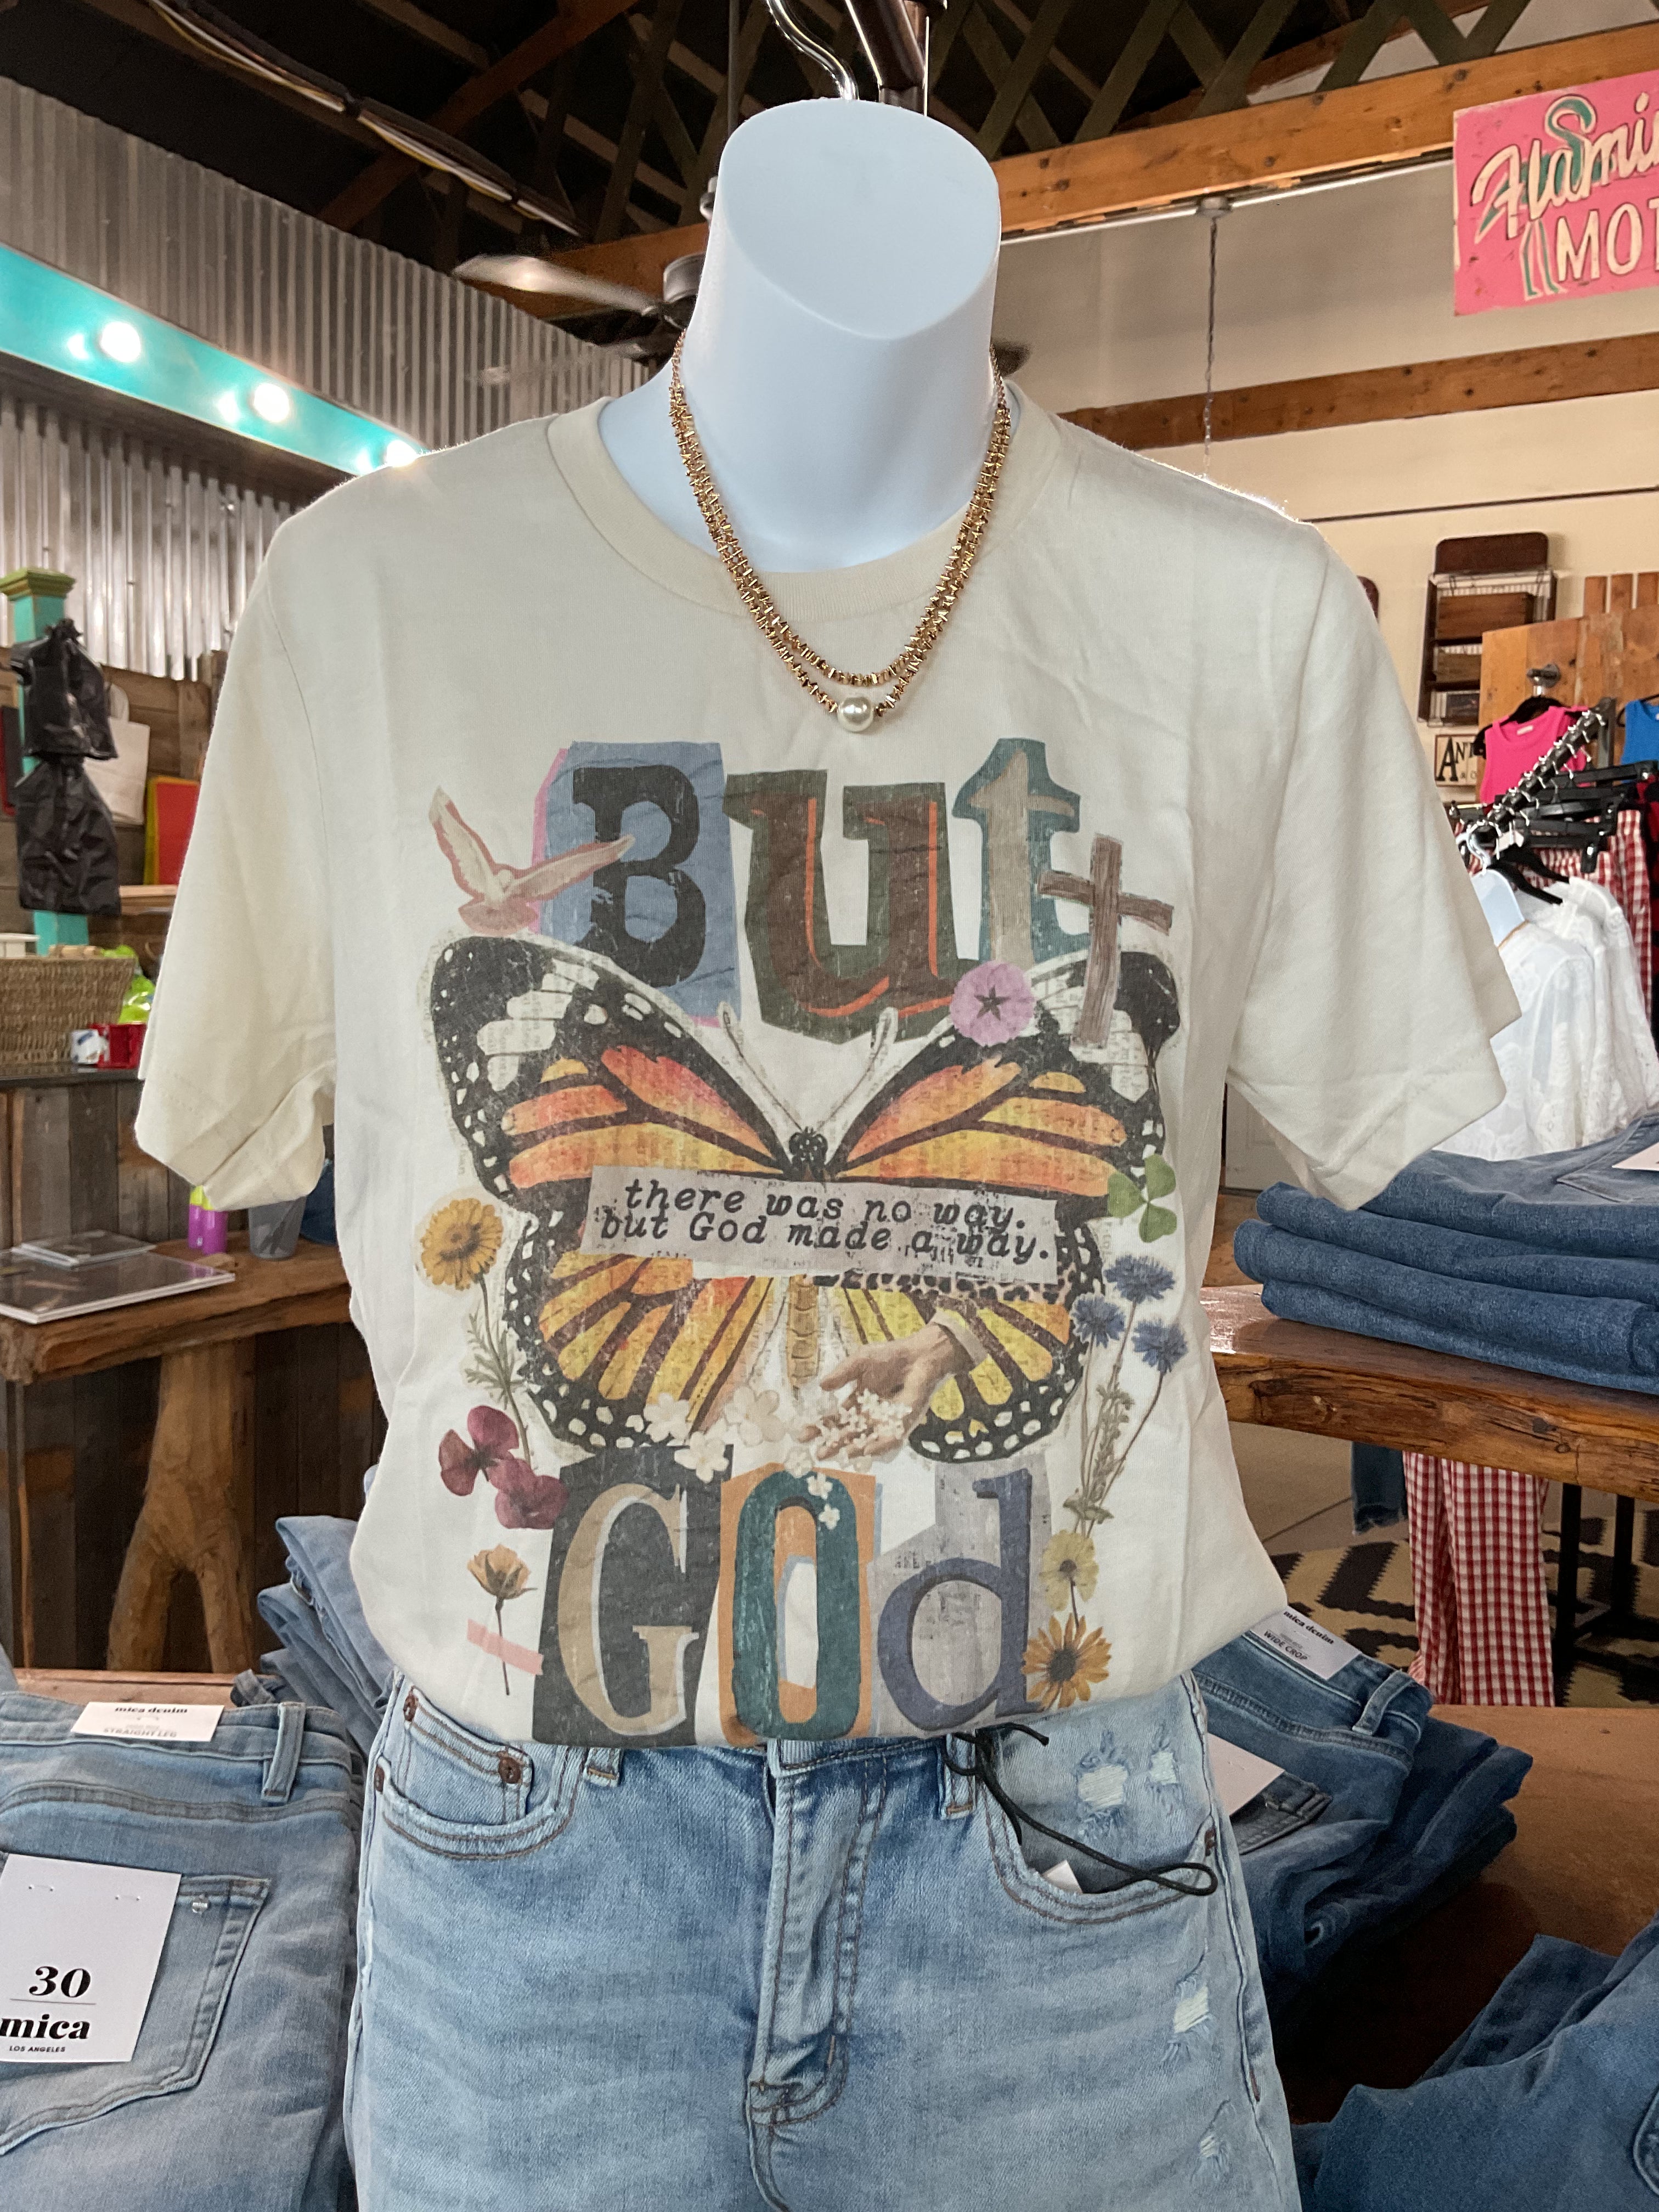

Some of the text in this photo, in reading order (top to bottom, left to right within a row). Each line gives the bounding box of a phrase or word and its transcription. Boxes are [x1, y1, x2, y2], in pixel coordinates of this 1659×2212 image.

[1470, 92, 1659, 240] Flami
[625, 1179, 1025, 1234] there was no way.
[601, 1206, 1048, 1265] but God made a way.
[1284, 1611, 1305, 1627] mica
[1264, 1630, 1286, 1648] WIDE
[1285, 1646, 1308, 1661] CROP
[103, 1728, 178, 1738] STRAIGHT LEG
[29, 1966, 91, 1998] 30
[0, 2013, 91, 2040] mica
